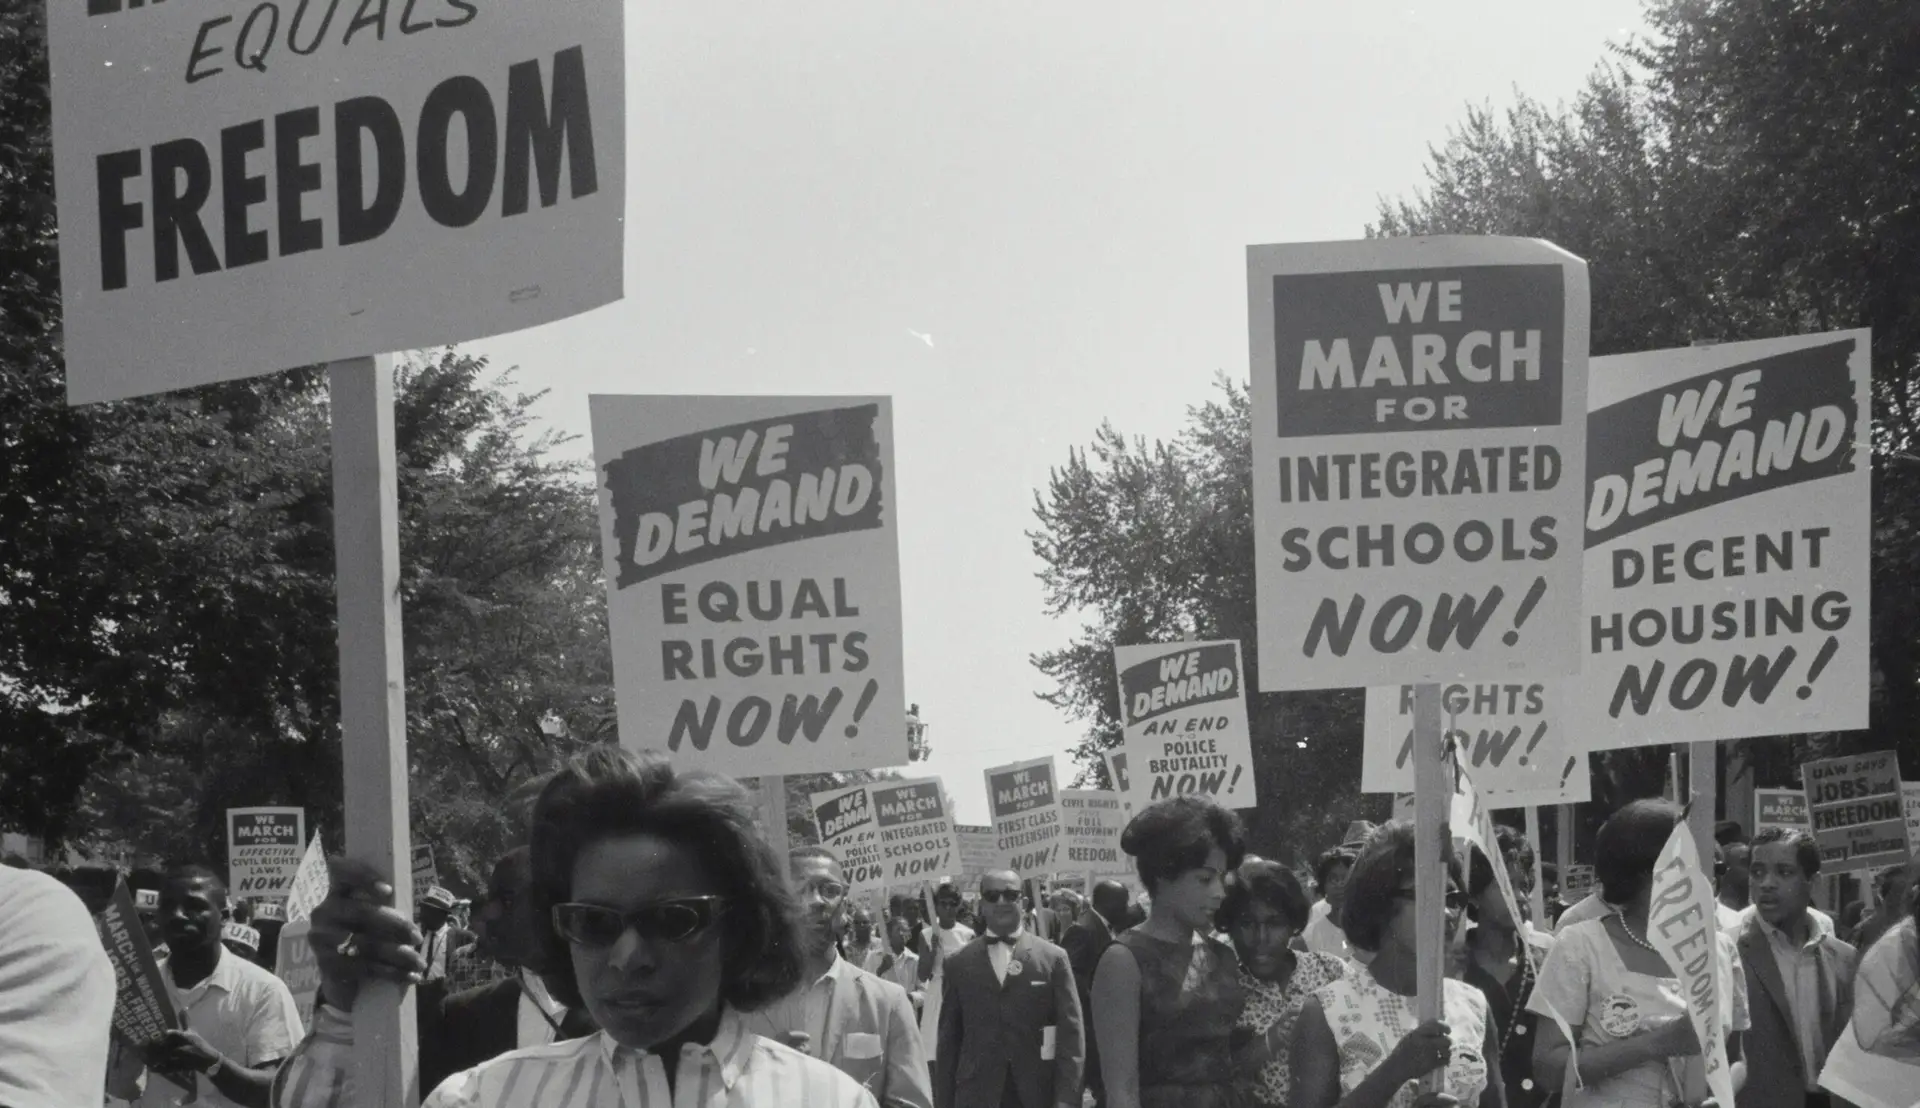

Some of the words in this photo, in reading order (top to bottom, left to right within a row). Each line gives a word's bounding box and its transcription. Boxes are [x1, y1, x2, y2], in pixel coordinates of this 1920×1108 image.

[96, 45, 598, 291] FREEDOM
[1377, 280, 1462, 324] WE
[1299, 329, 1542, 390] MARCH
[1376, 396, 1469, 422] FOR
[1657, 369, 1762, 448] WE
[699, 424, 794, 489] WE
[1585, 404, 1847, 532] DEMAND
[1278, 444, 1562, 502] INTEGRATED
[632, 463, 874, 567] DEMAND
[1281, 515, 1559, 573] SCHOOLS
[1612, 527, 1831, 589] DECENT
[661, 577, 860, 625] EQUAL
[1302, 575, 1547, 658] NOW!
[1590, 590, 1852, 654] HOUSING
[661, 631, 870, 681] RIGHTS
[1160, 651, 1201, 682] WE
[1608, 635, 1840, 719] NOW!
[1132, 667, 1234, 718] DEMAND
[1399, 683, 1545, 715] RGHTS
[667, 678, 879, 753] NOW!
[1143, 719, 1178, 736] AN
[1184, 716, 1230, 733] END
[1163, 739, 1217, 757] POLICE
[1150, 754, 1228, 774] BRUTALITY
[1812, 764, 1848, 780] UAW
[998, 780, 1049, 805] MARCH
[1013, 771, 1031, 786] WE
[1151, 764, 1243, 801] NOW!
[1812, 777, 1870, 803] JOBS
[838, 791, 864, 813] WE
[881, 796, 937, 818] MARCH
[895, 787, 917, 799] WE
[1061, 798, 1085, 809] CIVIL
[254, 815, 275, 825] WE
[824, 805, 871, 837] DEMA
[900, 812, 923, 823] FOR
[998, 817, 1027, 835] FIRST
[1028, 809, 1058, 829] CLASS
[1813, 800, 1903, 830] FREEDOM
[238, 826, 294, 838] MARCH
[832, 835, 853, 848] AN
[880, 820, 948, 843] INTEGRATED
[998, 825, 1061, 851] CITIZENSHIP
[1065, 826, 1119, 837] MPLOYMENT
[231, 857, 259, 867] CIVIL
[261, 856, 301, 866] RIGHTS
[239, 847, 296, 857] EFFECTIVE
[845, 843, 879, 859] POLICE
[884, 836, 951, 860] SCHOOLS
[1010, 842, 1060, 871] NOW!
[1067, 847, 1118, 862] REEDOM
[250, 866, 282, 876] LAWS
[894, 851, 950, 879] NOW!
[105, 903, 139, 966] MARCH
[1650, 856, 1713, 1016] FREEDOM
[130, 996, 162, 1041] FREEDO
